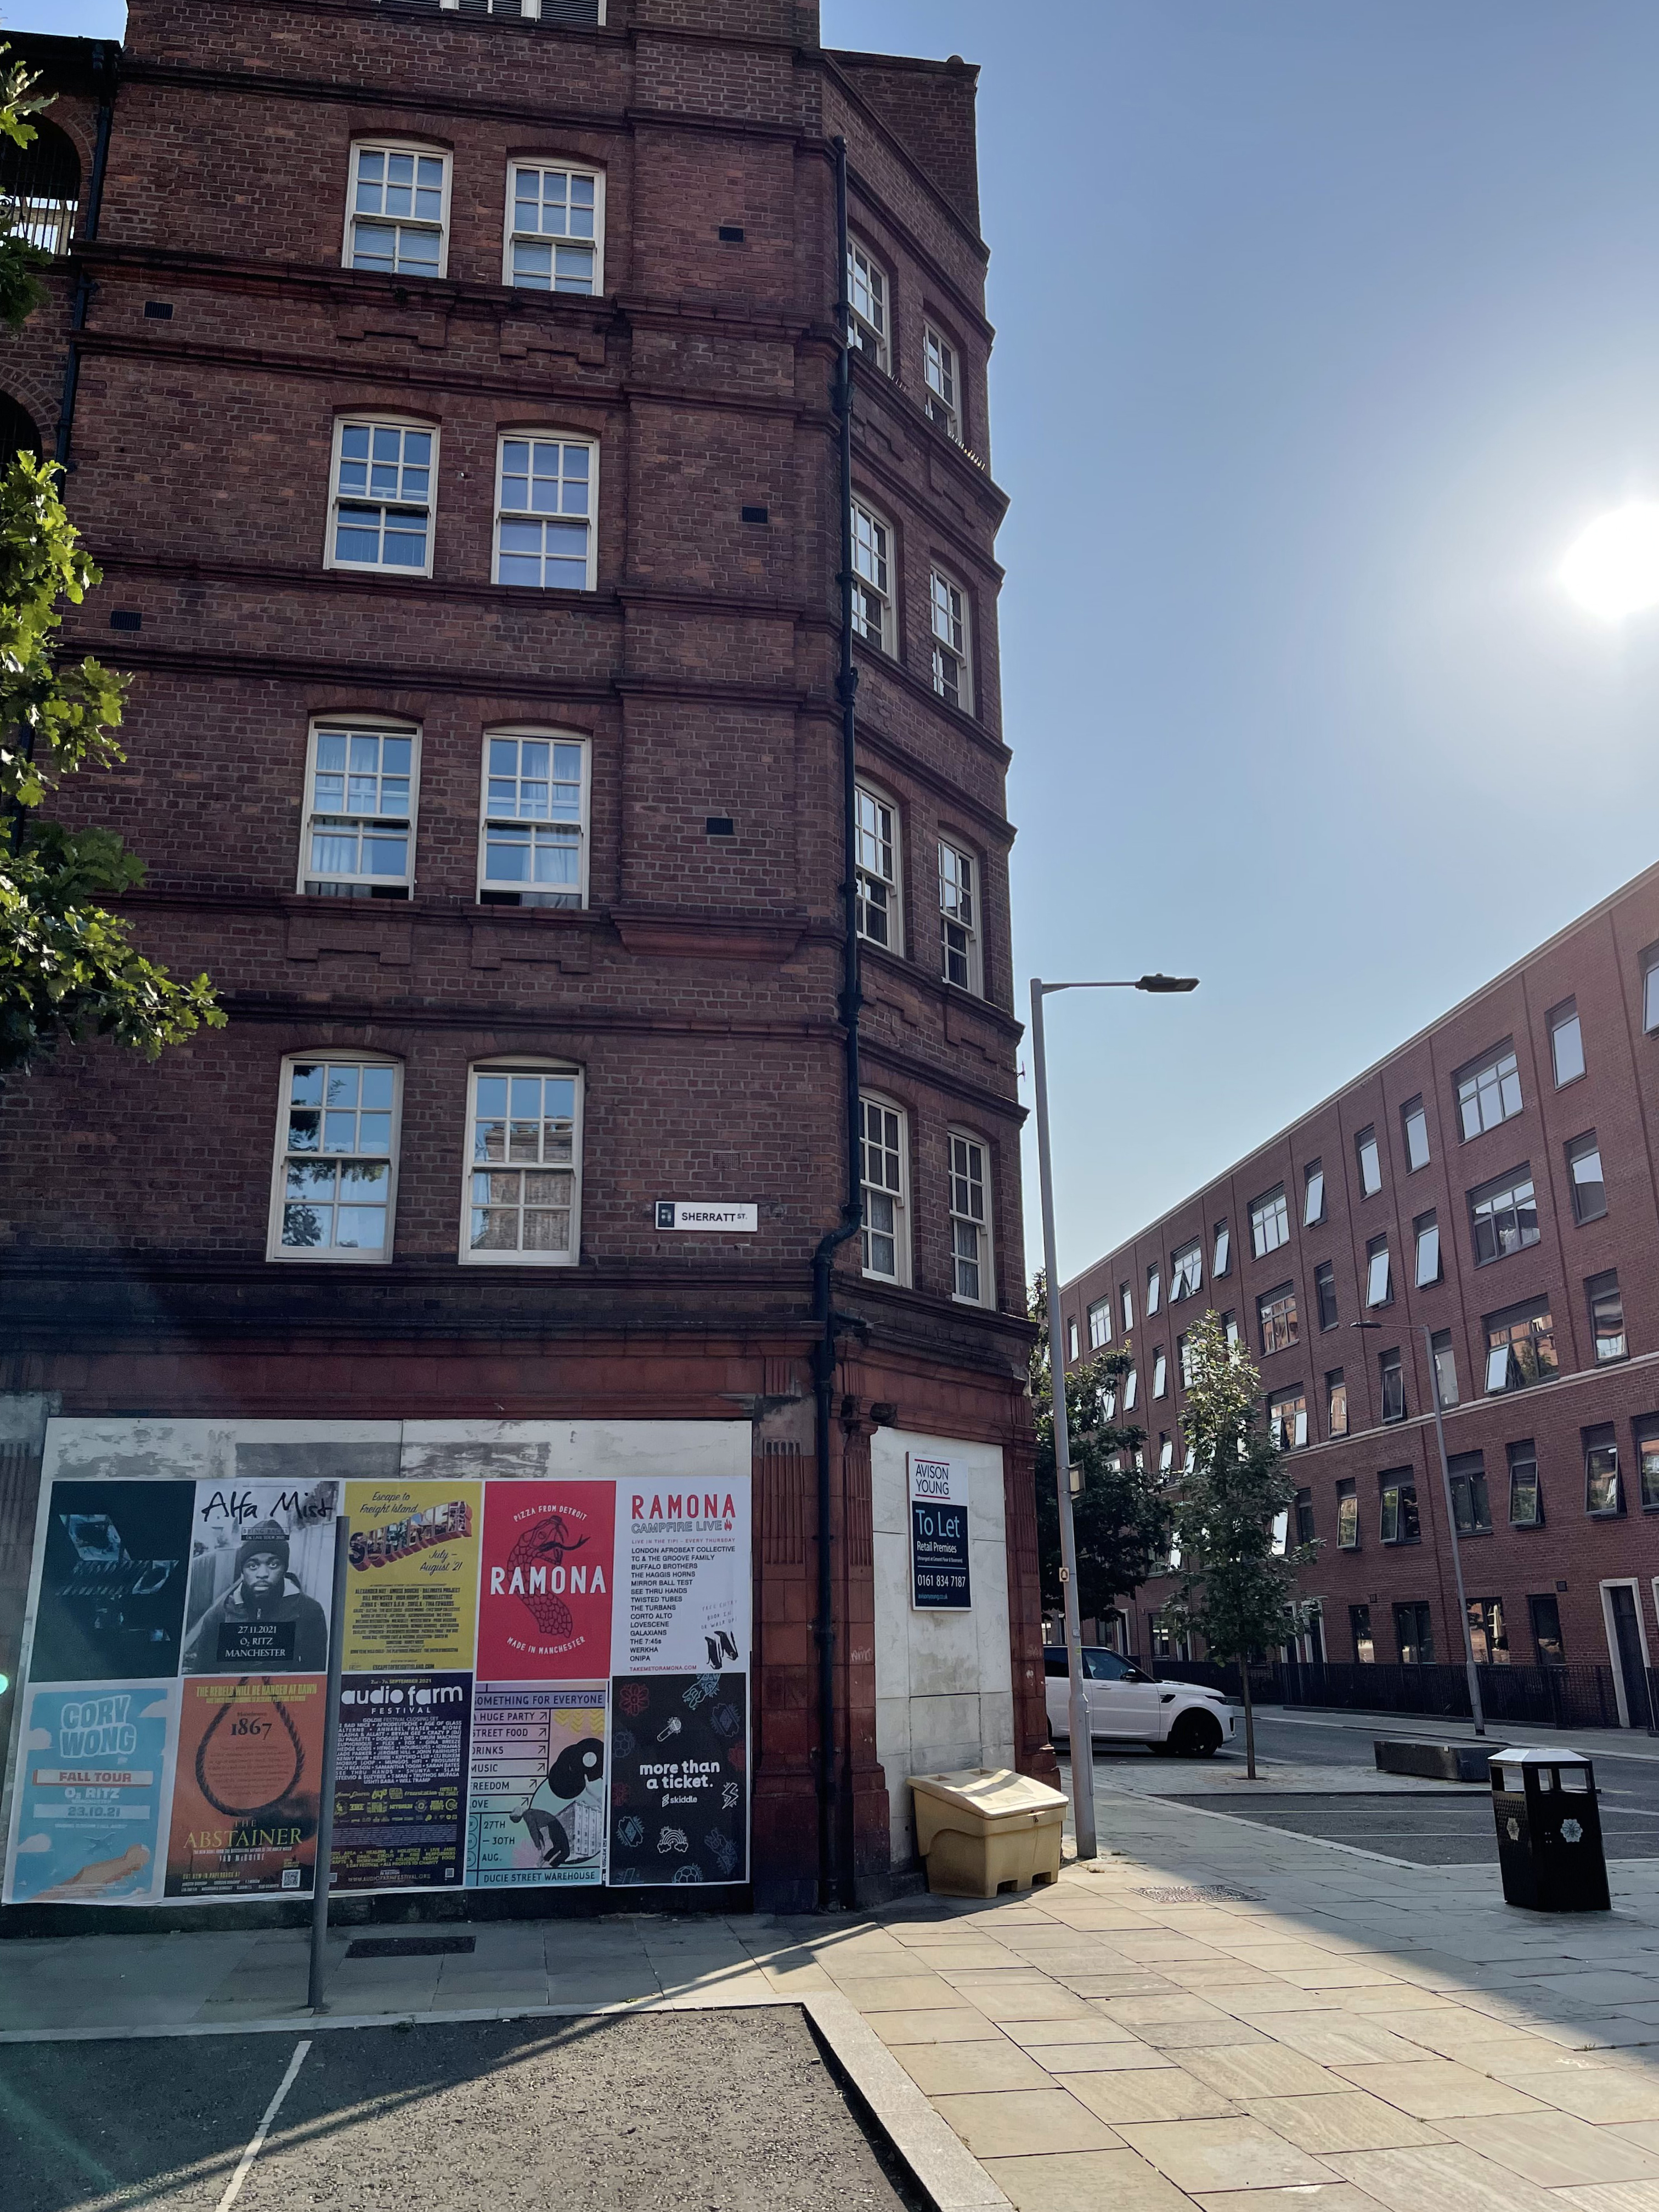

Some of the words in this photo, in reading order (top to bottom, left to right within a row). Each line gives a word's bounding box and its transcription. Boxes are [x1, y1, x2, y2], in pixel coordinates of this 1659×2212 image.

[681, 1212, 736, 1222] SHERRATT
[916, 1464, 949, 1481] AVISON
[916, 1479, 949, 1495] YOUNG
[372, 1492, 400, 1502] Escape
[402, 1492, 410, 1501] to
[201, 1491, 257, 1524] Alfa
[270, 1491, 334, 1519] Mist
[359, 1504, 391, 1517] Freight
[391, 1503, 419, 1513] Island
[632, 1494, 736, 1519] RAMONA
[514, 1508, 536, 1522] PIZZA
[538, 1505, 556, 1513] FROM
[559, 1505, 588, 1521] DETROIT
[631, 1521, 692, 1534] CAMPFIRE
[696, 1520, 722, 1531] LIVE
[915, 1509, 933, 1536] To
[938, 1511, 960, 1538] Let
[349, 1501, 472, 1571] SUMMER
[917, 1541, 933, 1551] Retail
[933, 1542, 957, 1553] Premises
[428, 1550, 449, 1562] July
[420, 1561, 450, 1576] August
[490, 1565, 606, 1595] RAMONA
[917, 1575, 933, 1586] 0161
[936, 1575, 949, 1587] 834
[951, 1576, 966, 1587] 7187
[702, 1603, 716, 1612] FREE
[710, 1620, 725, 1628] WALK
[506, 1637, 527, 1651] MADE
[528, 1645, 536, 1654] IN
[538, 1636, 585, 1655] MANCHESTER
[225, 1649, 285, 1657] MANCHESTER
[196, 1686, 209, 1697] THE
[210, 1686, 236, 1696] REBELS
[236, 1685, 251, 1696] WILL
[252, 1685, 260, 1695] BE
[262, 1685, 287, 1695] HANGED
[288, 1684, 297, 1695] AT
[298, 1684, 317, 1694] DAWN
[341, 1685, 404, 1705] audio
[408, 1685, 463, 1706] farm
[533, 1695, 550, 1704] FOR
[554, 1694, 603, 1704] EVERYONE
[61, 1695, 131, 1729] CORY
[480, 1713, 504, 1721] HUGE
[507, 1712, 535, 1720] PARTY
[230, 1718, 273, 1740] 1867
[506, 1728, 528, 1737] FOOD
[60, 1724, 137, 1757] WONG
[640, 1763, 678, 1775] more
[681, 1759, 720, 1773] than
[59, 1771, 91, 1782] FALL
[94, 1772, 132, 1782] TOUR
[646, 1778, 658, 1790] a
[662, 1774, 714, 1789] ticket.
[85, 1787, 121, 1799] RITZ
[670, 1795, 697, 1803] skiddle
[471, 1799, 489, 1808] OVE
[67, 1806, 121, 1817] 23.10.21
[235, 1819, 256, 1827] THE
[483, 1821, 506, 1830] 27TH
[183, 1827, 302, 1849] ABSTAINER
[484, 1874, 509, 1883] DUCIE
[511, 1873, 542, 1882] STREET
[544, 1871, 595, 1881] WAREHOUSE
